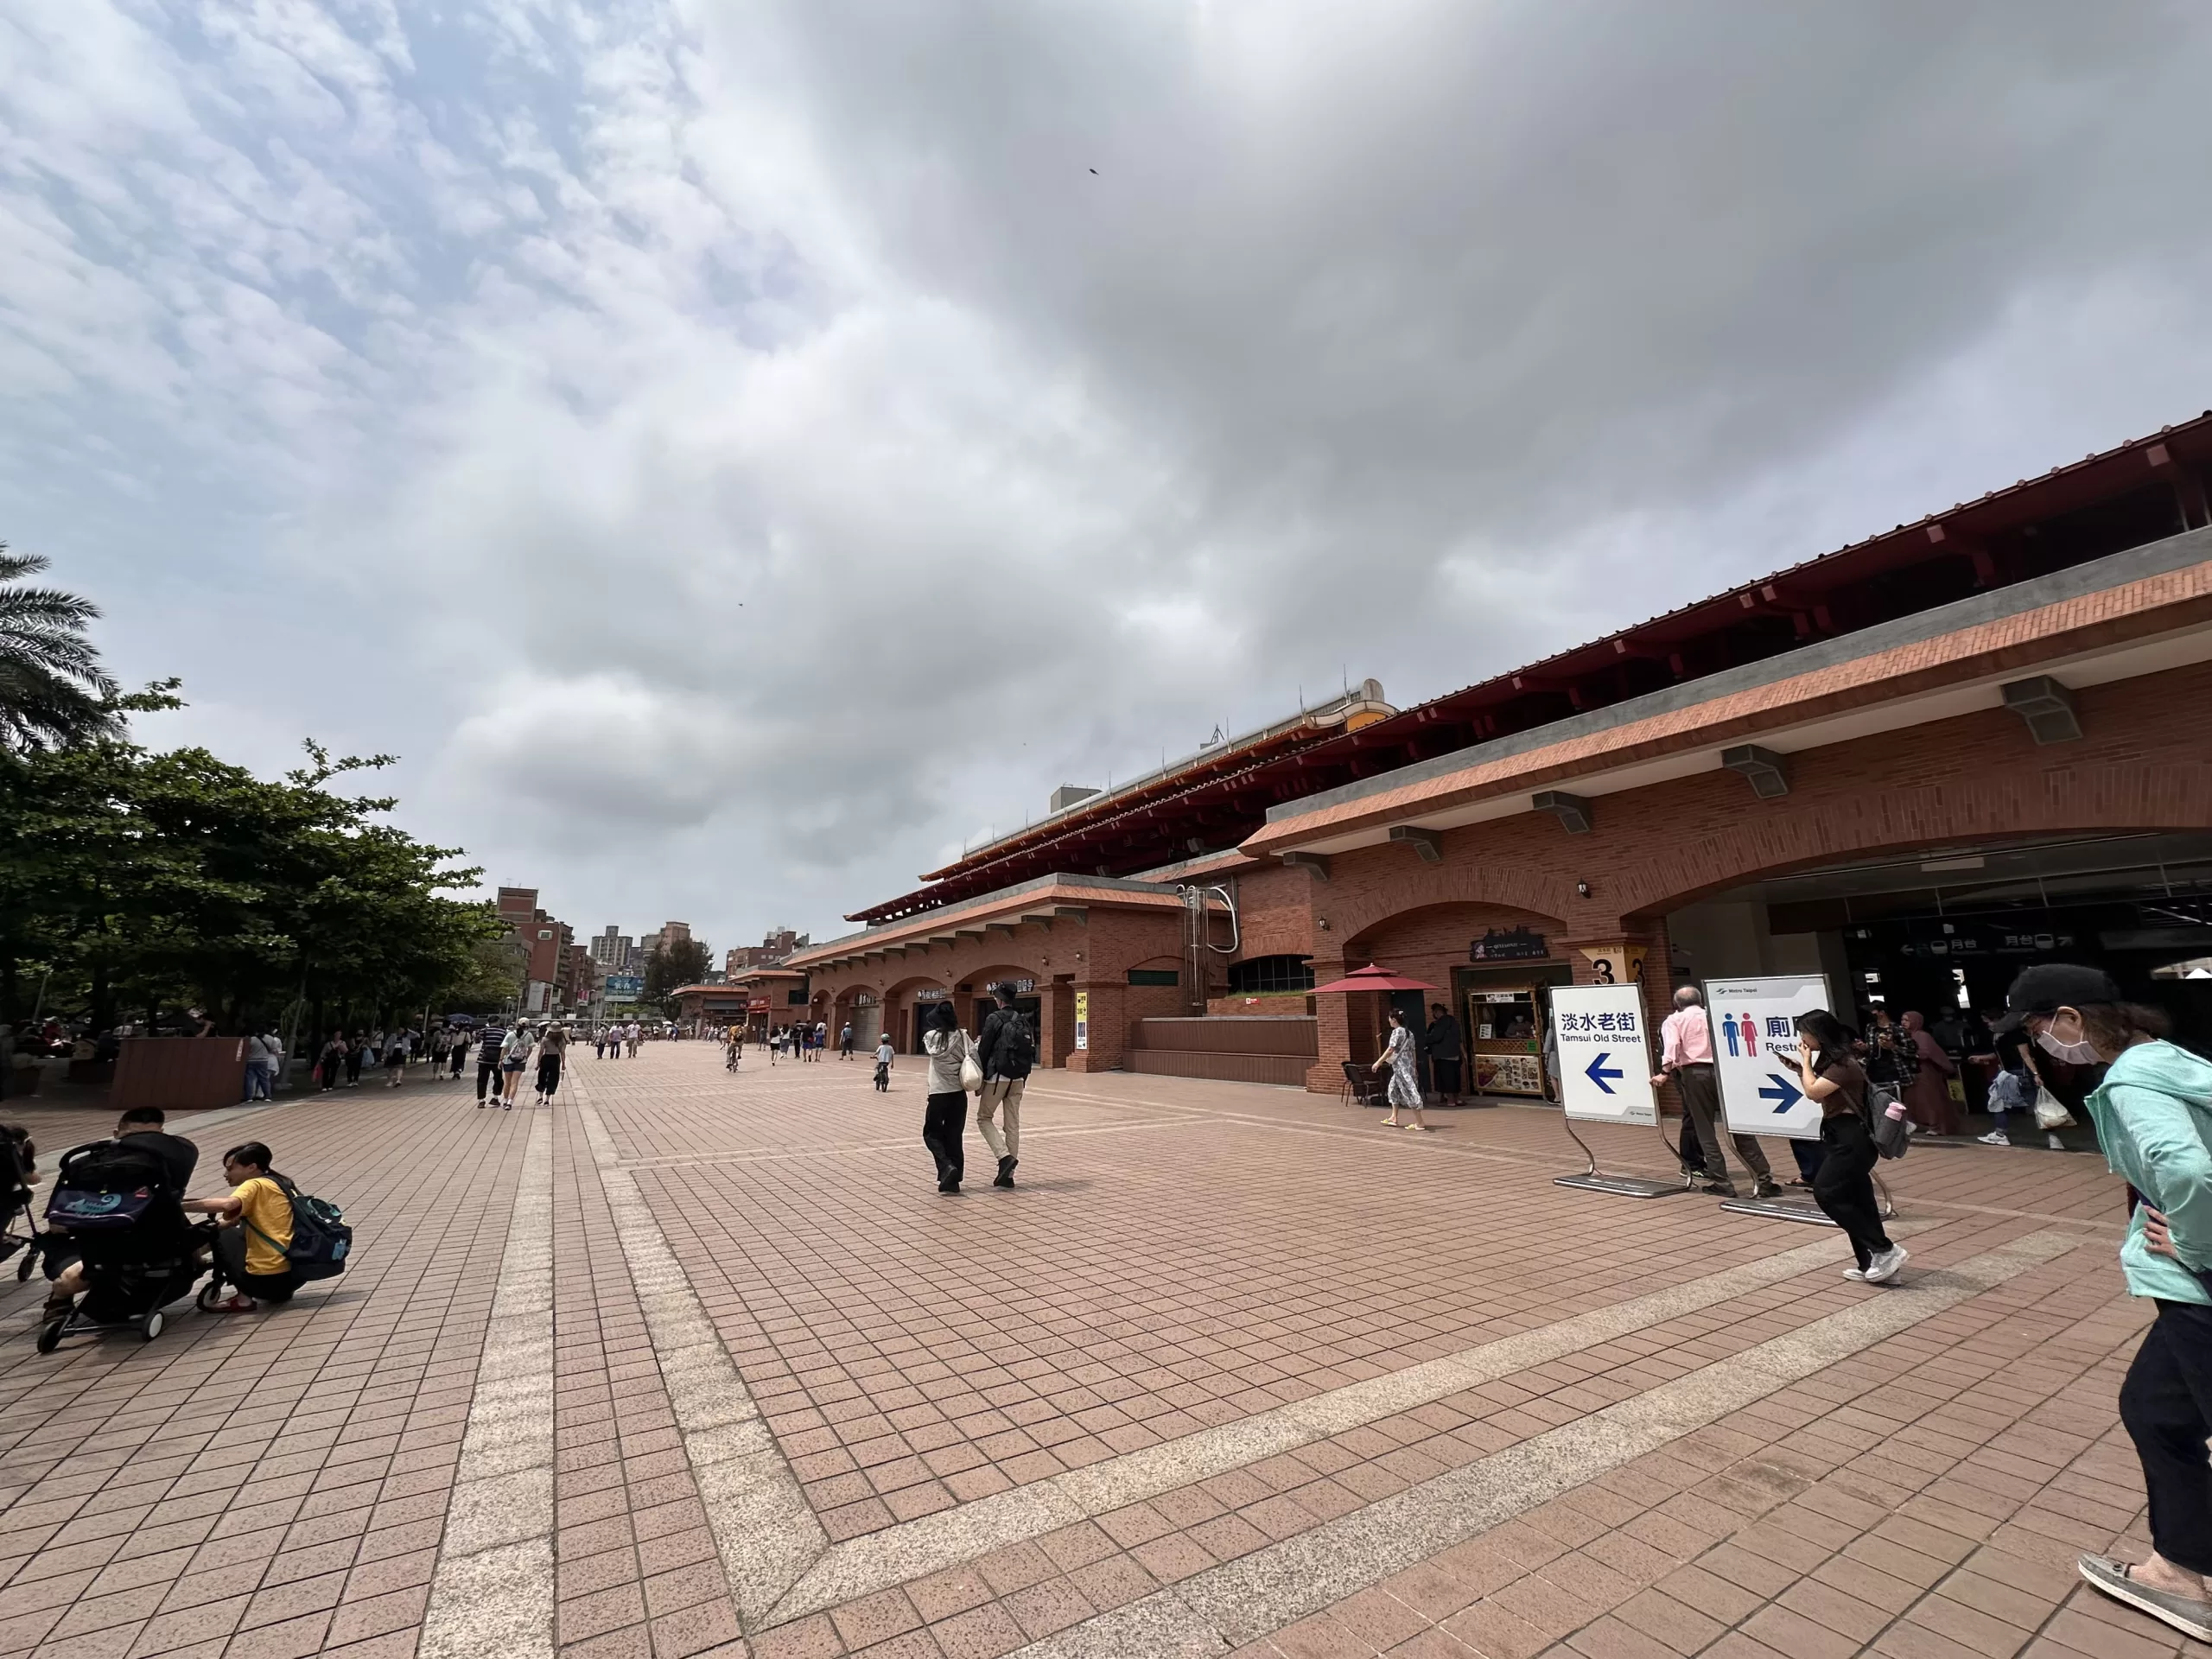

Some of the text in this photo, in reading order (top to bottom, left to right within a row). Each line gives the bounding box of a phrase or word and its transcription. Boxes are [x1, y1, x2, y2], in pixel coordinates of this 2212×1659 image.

[1951, 939, 1977, 950] 月台
[2005, 935, 2033, 945] 月台
[1592, 958, 1615, 984] 3
[1561, 1013, 1635, 1031] 淡水老街
[1560, 1033, 1642, 1043] Tamsui Old Street
